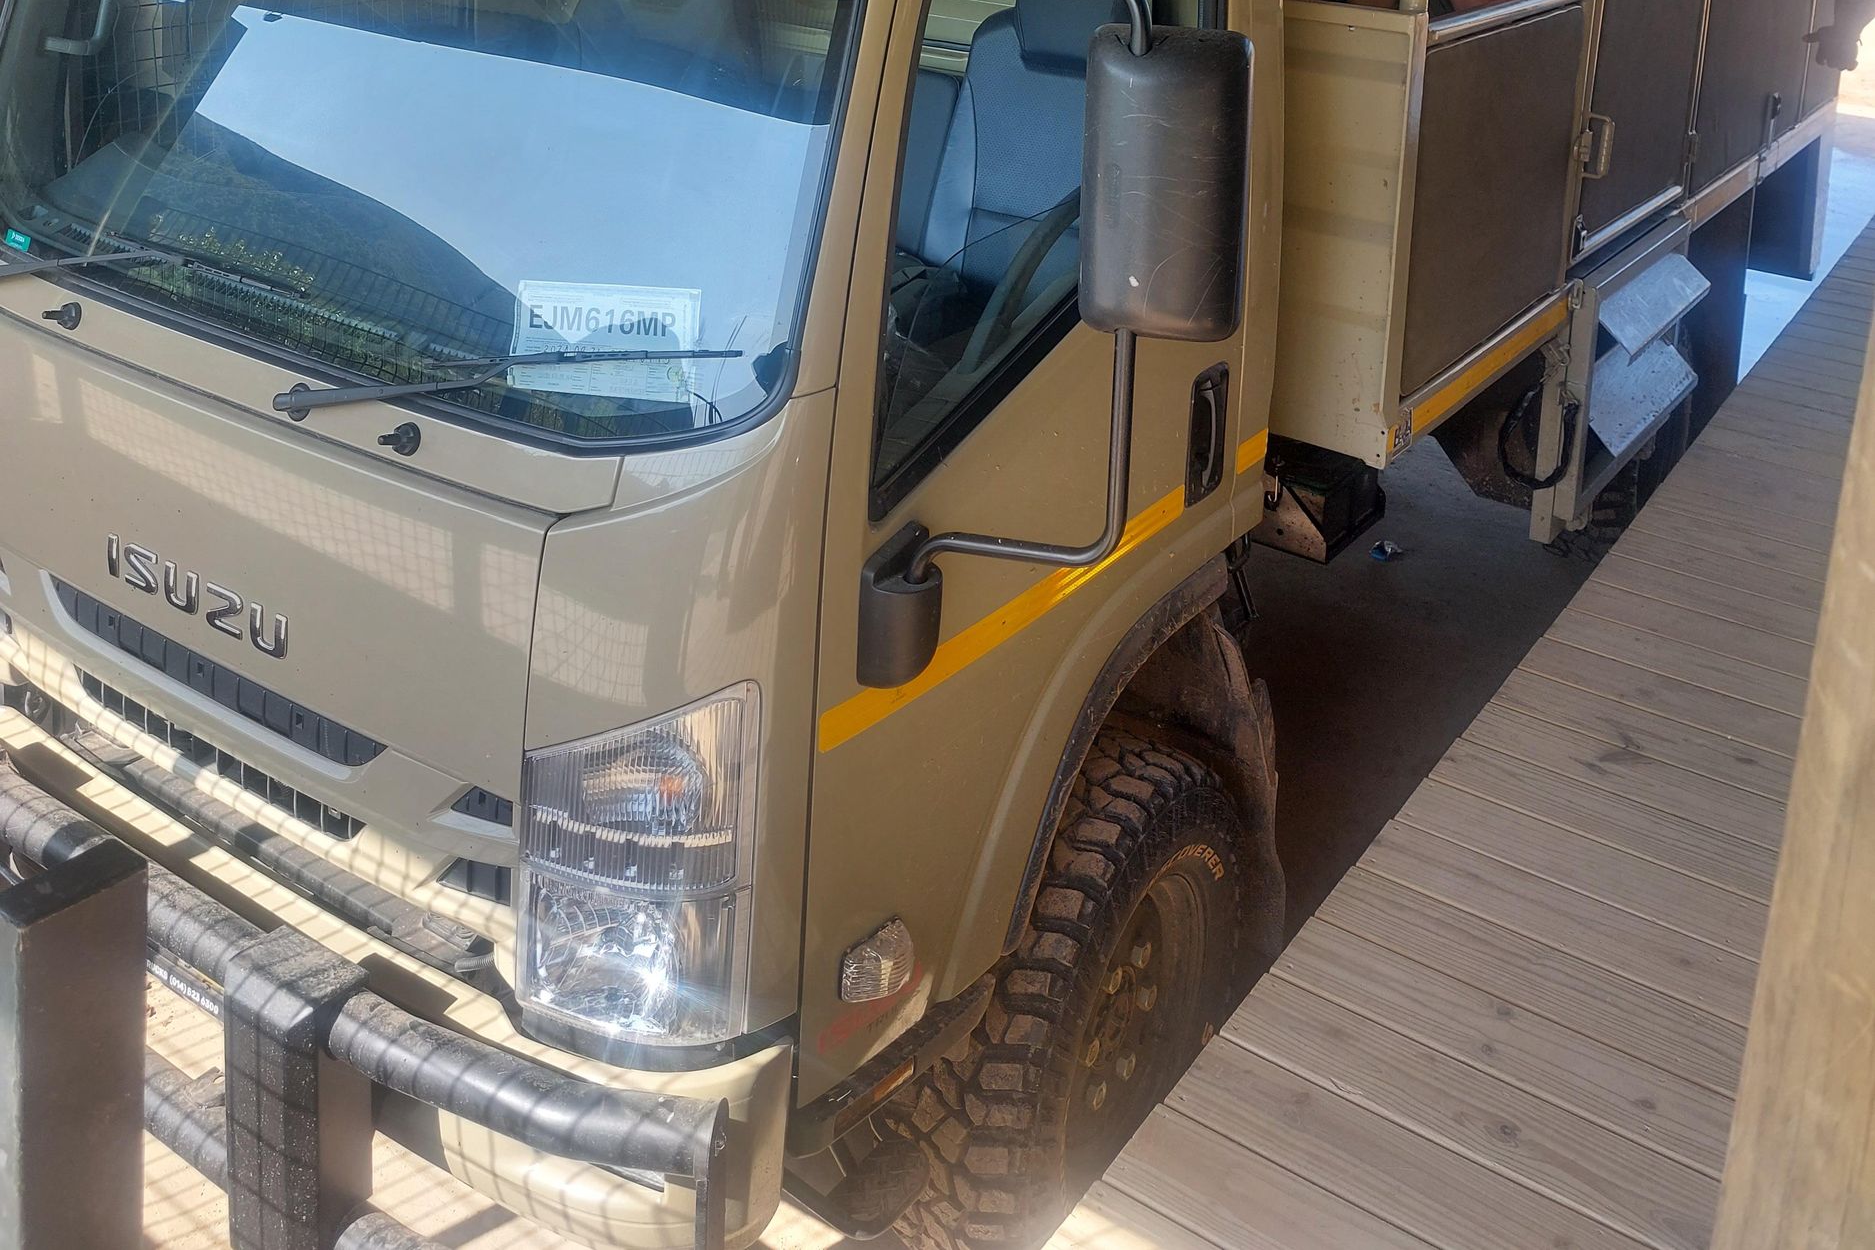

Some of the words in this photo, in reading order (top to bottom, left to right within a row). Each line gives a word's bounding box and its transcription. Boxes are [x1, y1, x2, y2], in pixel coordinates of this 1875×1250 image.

[529, 304, 677, 337] EJM616MP
[107, 532, 288, 660] ISUZU
[1156, 843, 1225, 881] COVERER
[200, 996, 219, 1015] 6300
